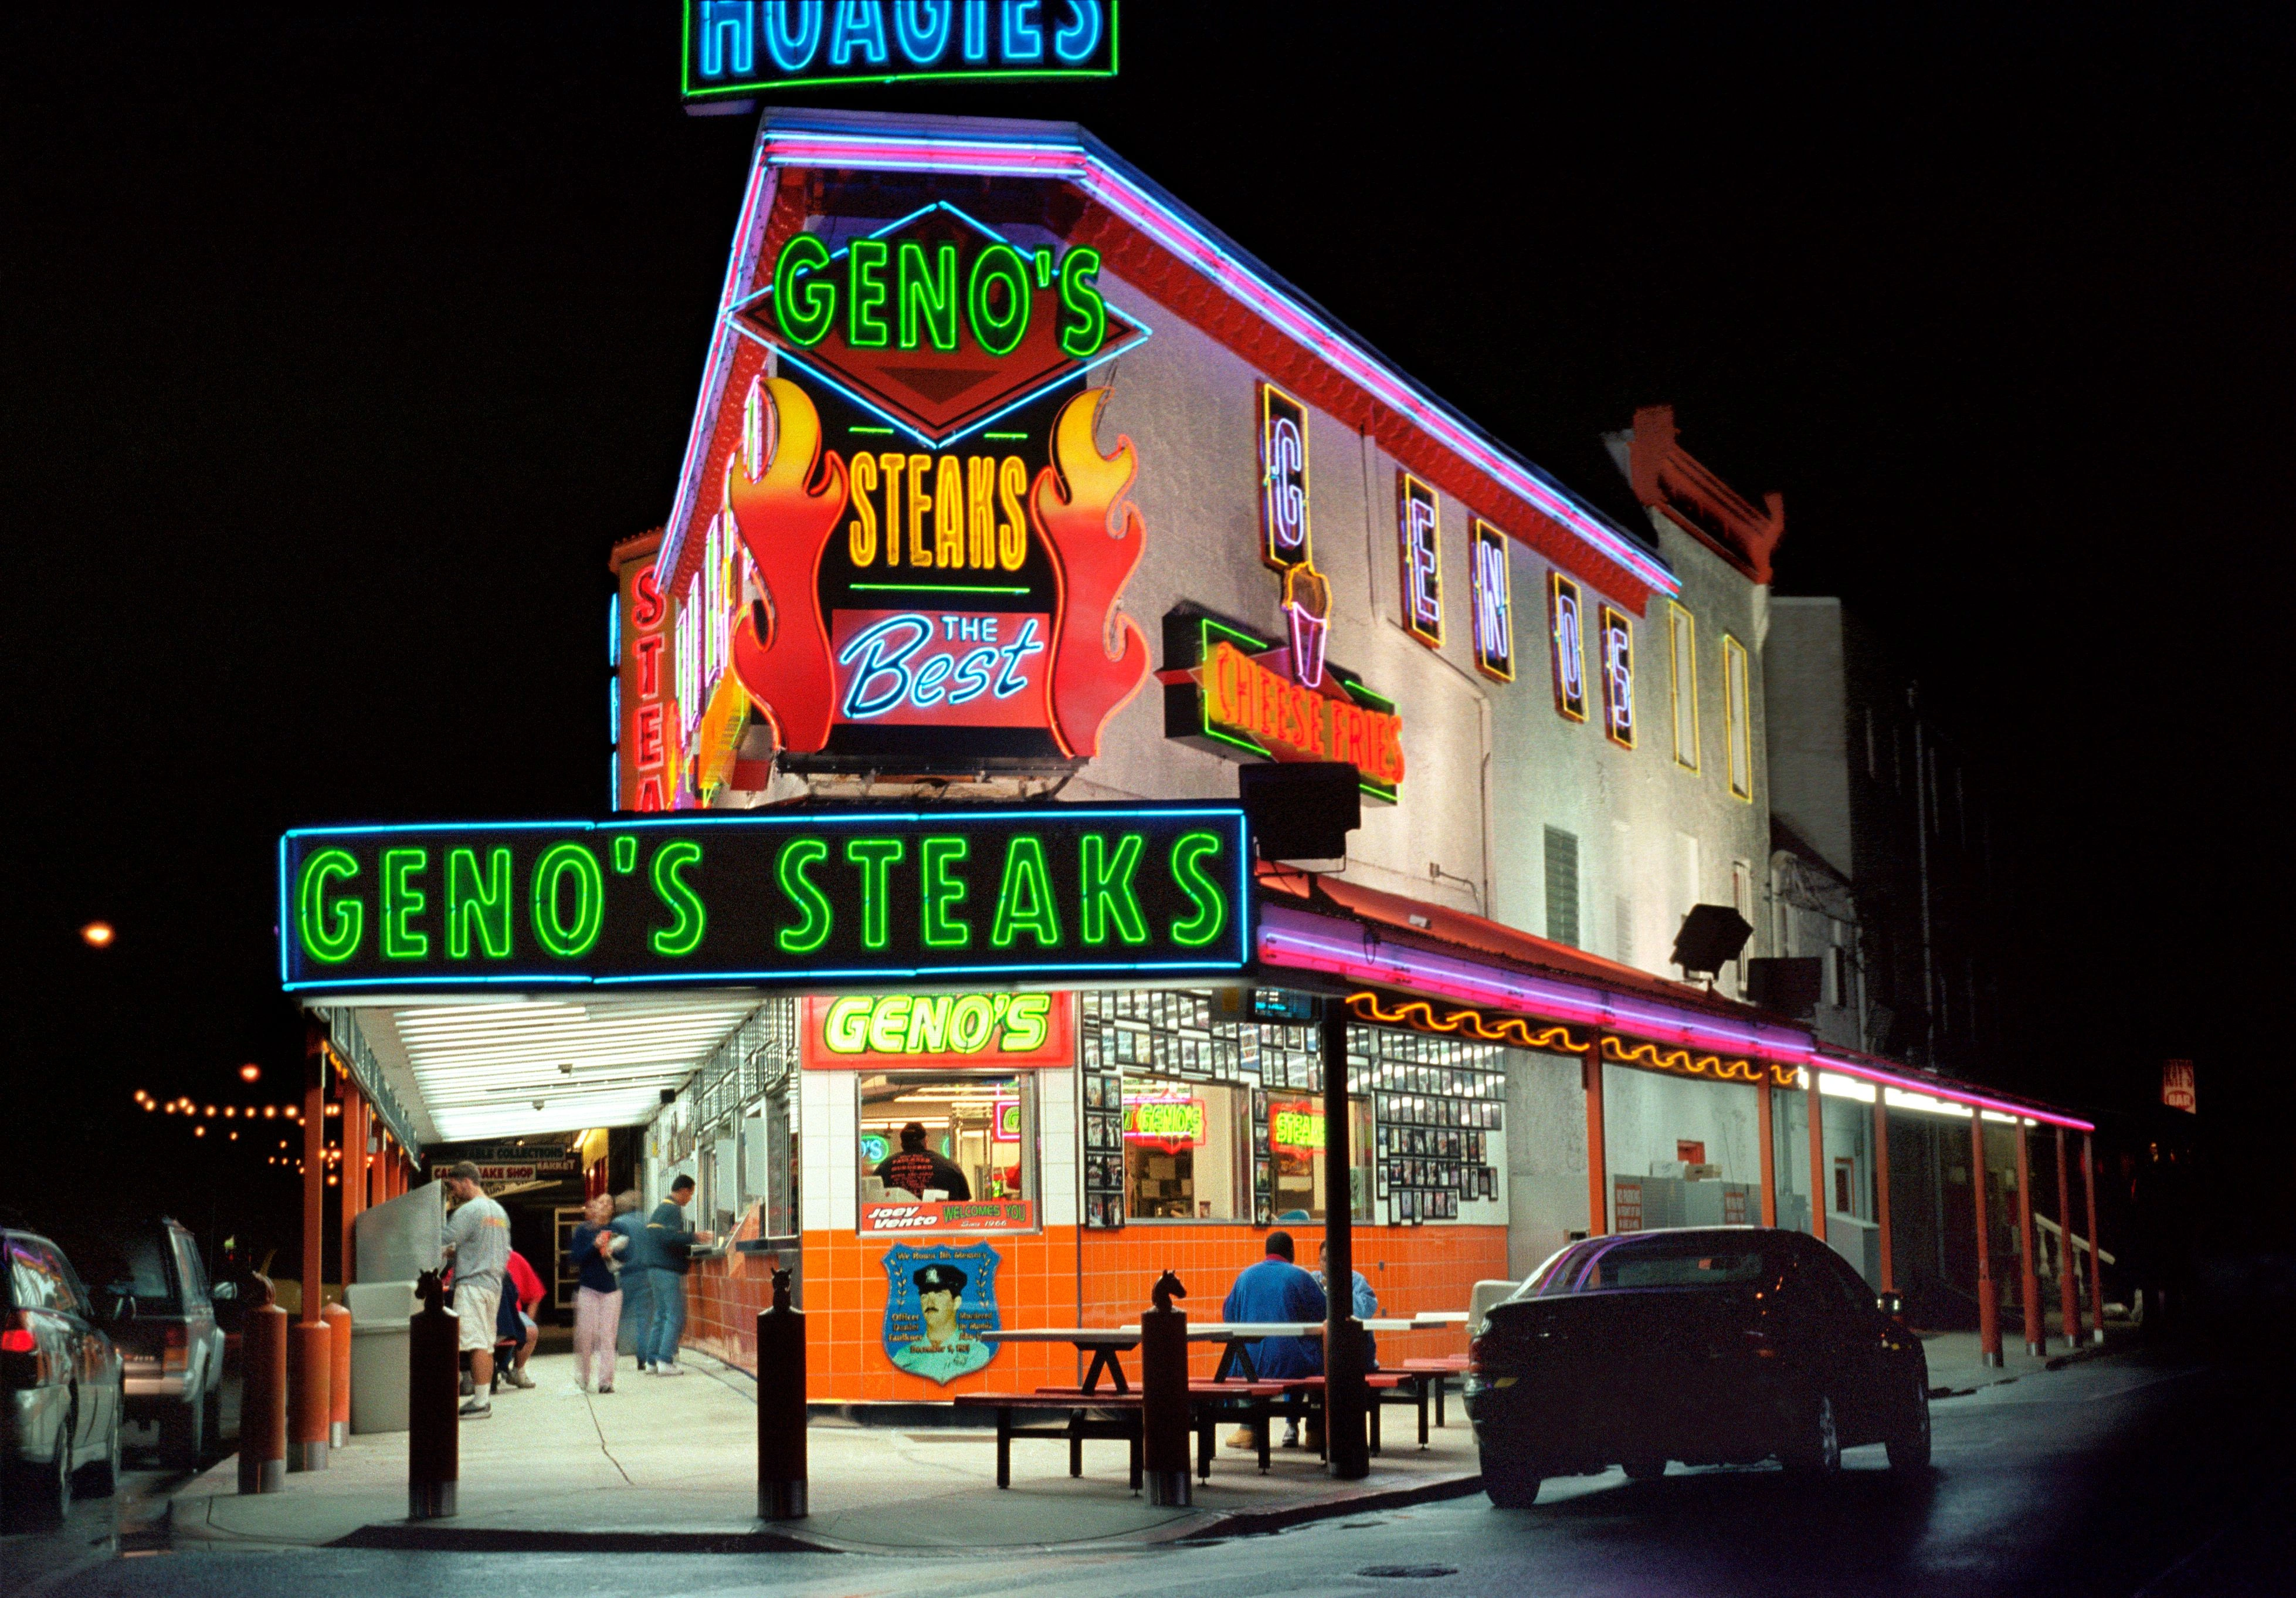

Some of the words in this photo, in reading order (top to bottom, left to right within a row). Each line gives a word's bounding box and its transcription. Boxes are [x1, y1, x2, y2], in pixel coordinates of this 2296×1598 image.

[700, 0, 1104, 77] HOAGIES
[773, 233, 1109, 358] GENO'S
[850, 451, 1027, 570] STEAKS
[942, 616, 998, 642] THE
[839, 614, 1044, 719] Best
[1216, 641, 1325, 755] CHEESE
[1331, 699, 1405, 784] FRIES
[297, 836, 706, 962] GENO'S
[775, 831, 1226, 953] STEAKS
[825, 994, 1051, 1054] GENO'S
[507, 1167, 533, 1179] SHOP
[868, 1206, 920, 1219] Joey
[874, 1216, 937, 1230] Vento
[942, 1204, 1001, 1223] WELCOMES
[1005, 1204, 1026, 1222] YOU
